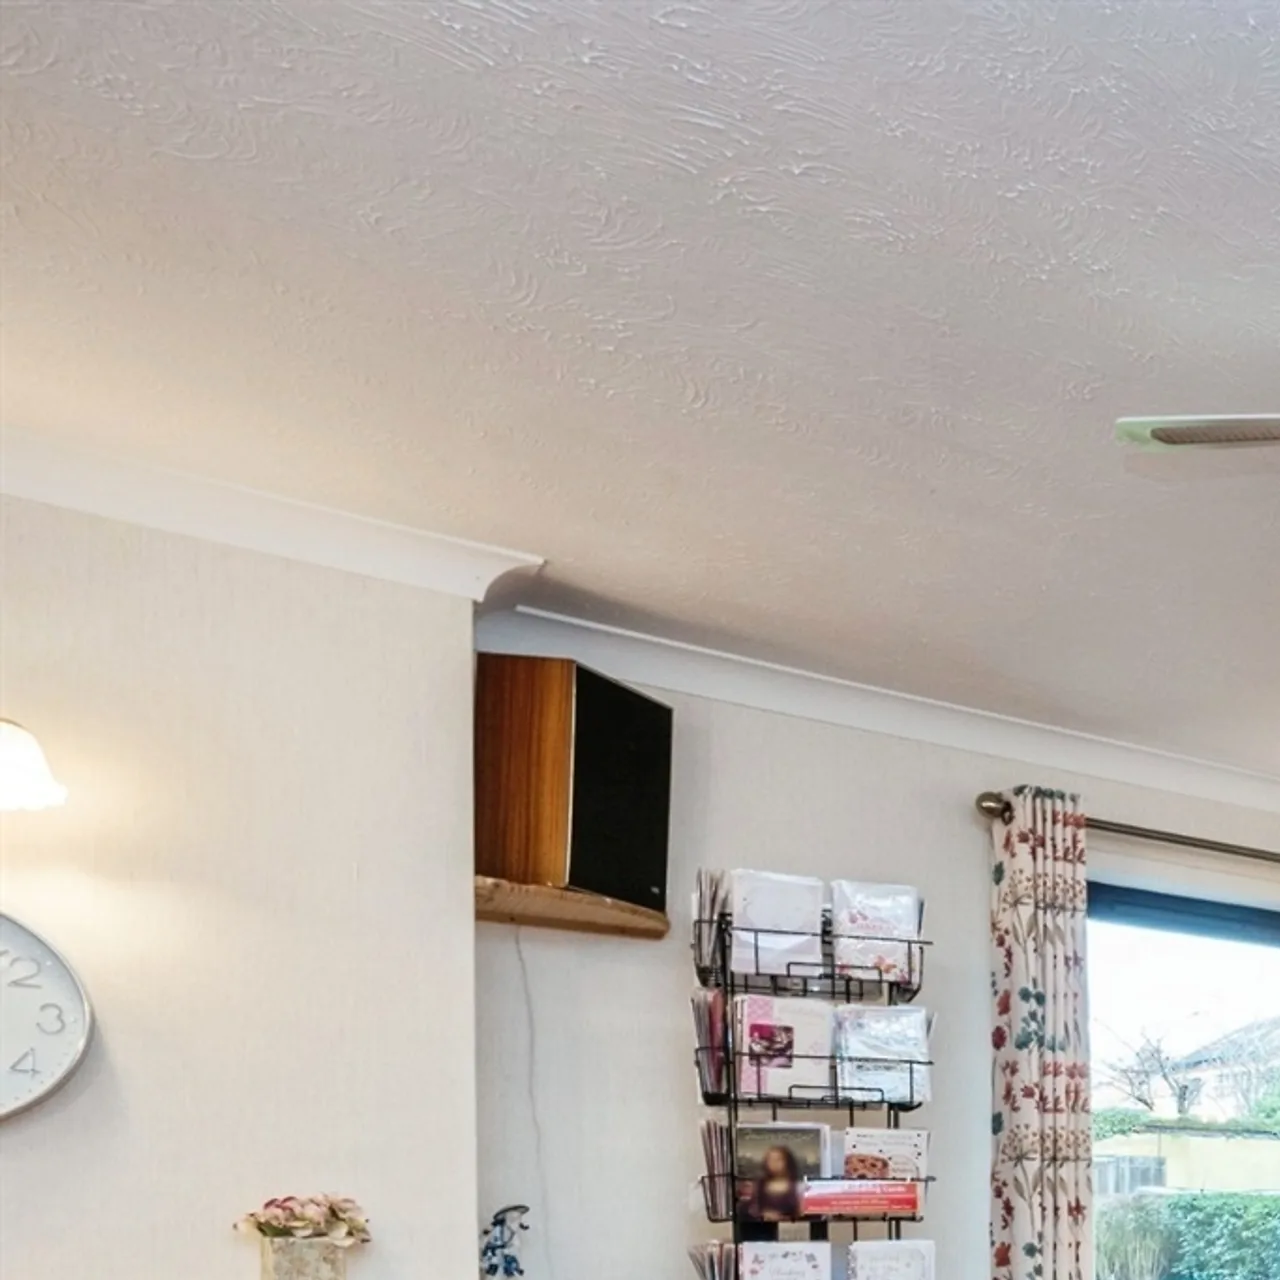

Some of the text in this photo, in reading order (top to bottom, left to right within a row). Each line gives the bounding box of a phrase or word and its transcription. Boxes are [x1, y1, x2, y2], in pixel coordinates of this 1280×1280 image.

[7, 956, 43, 989] 2
[36, 1003, 66, 1035] 3
[9, 1047, 41, 1079] 4
